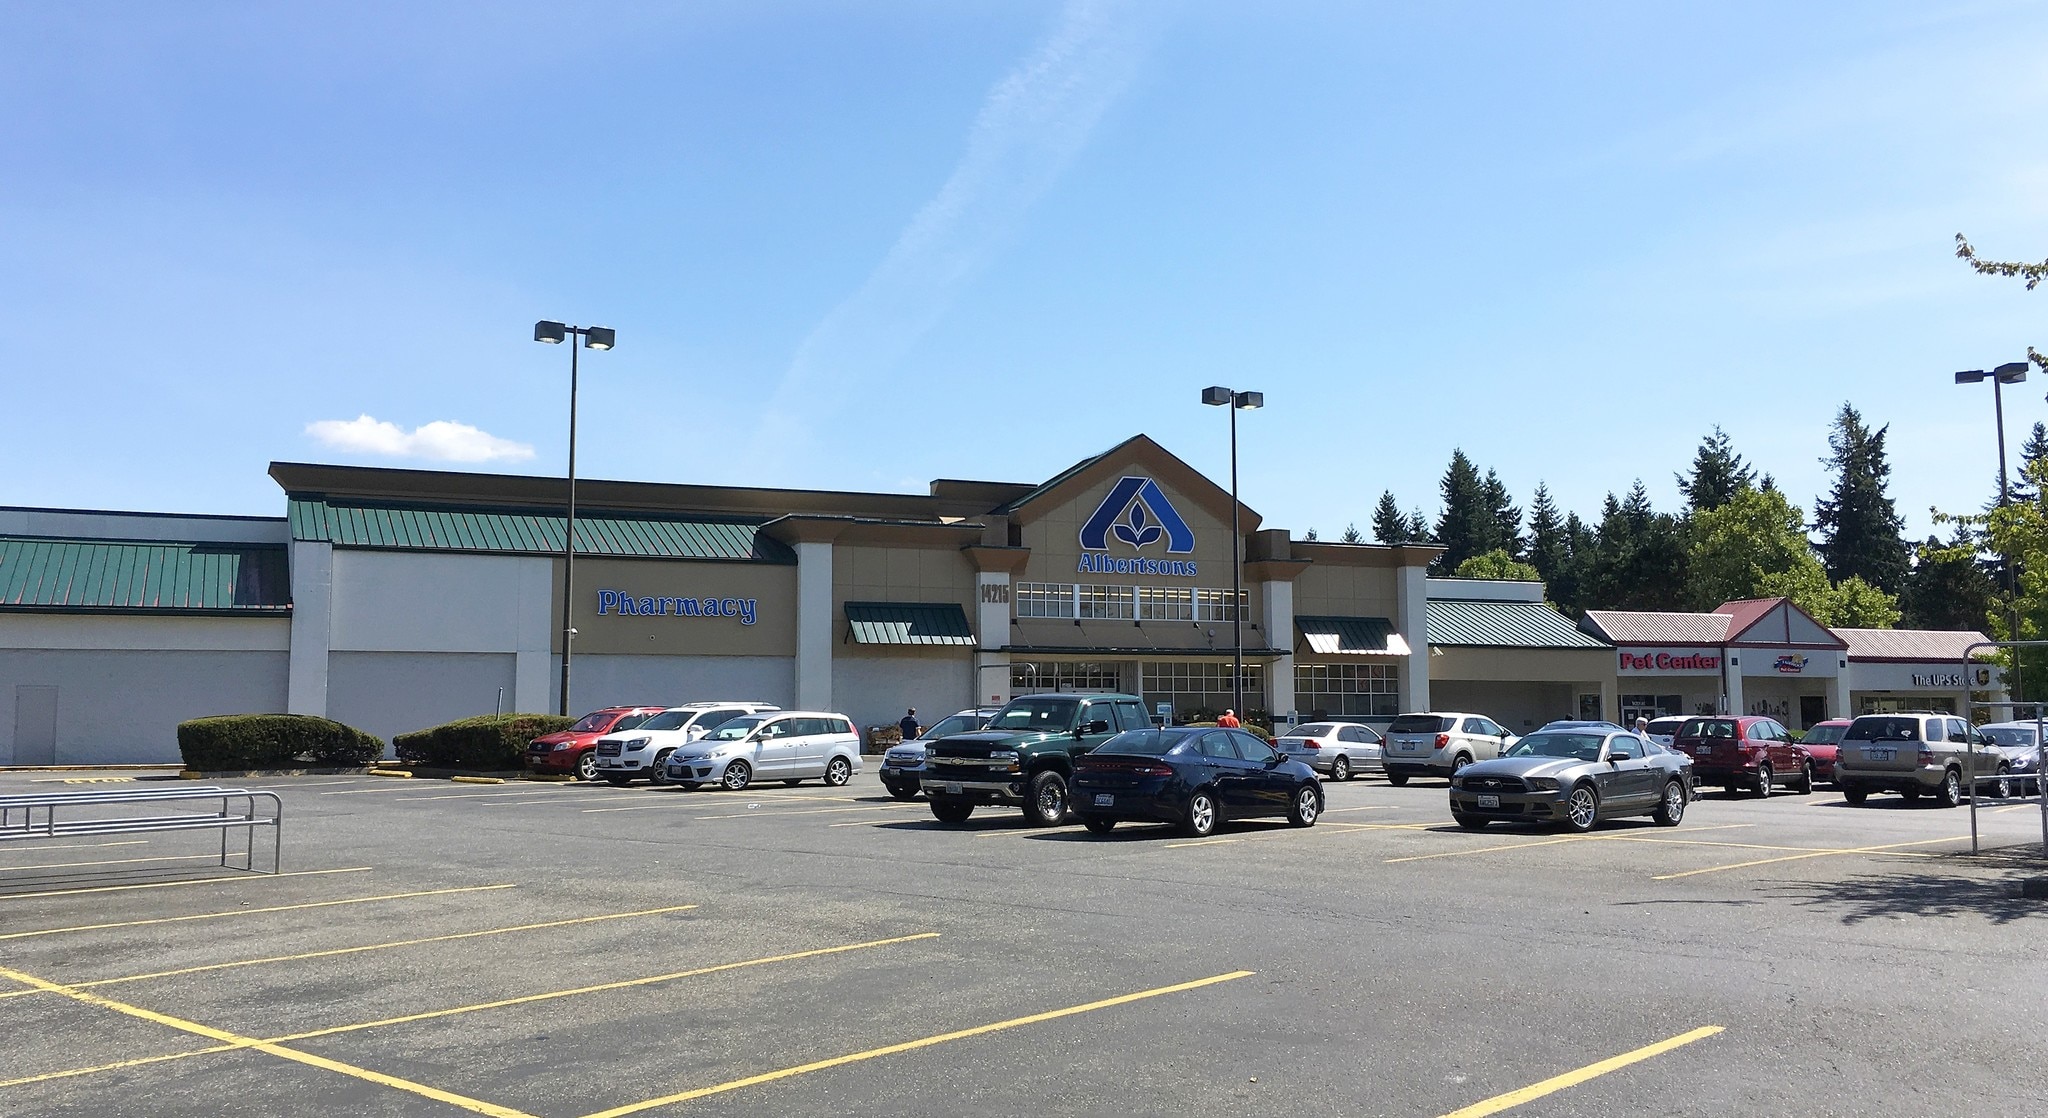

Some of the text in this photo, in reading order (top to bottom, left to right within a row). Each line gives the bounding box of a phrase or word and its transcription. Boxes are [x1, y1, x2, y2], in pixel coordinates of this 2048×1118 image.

[1078, 553, 1198, 577] Albertsons
[981, 584, 1010, 604] 14215
[597, 589, 757, 625] Pharmacy
[1620, 652, 1720, 669] Pet Center
[1912, 674, 1975, 686] The UPS Stoe
